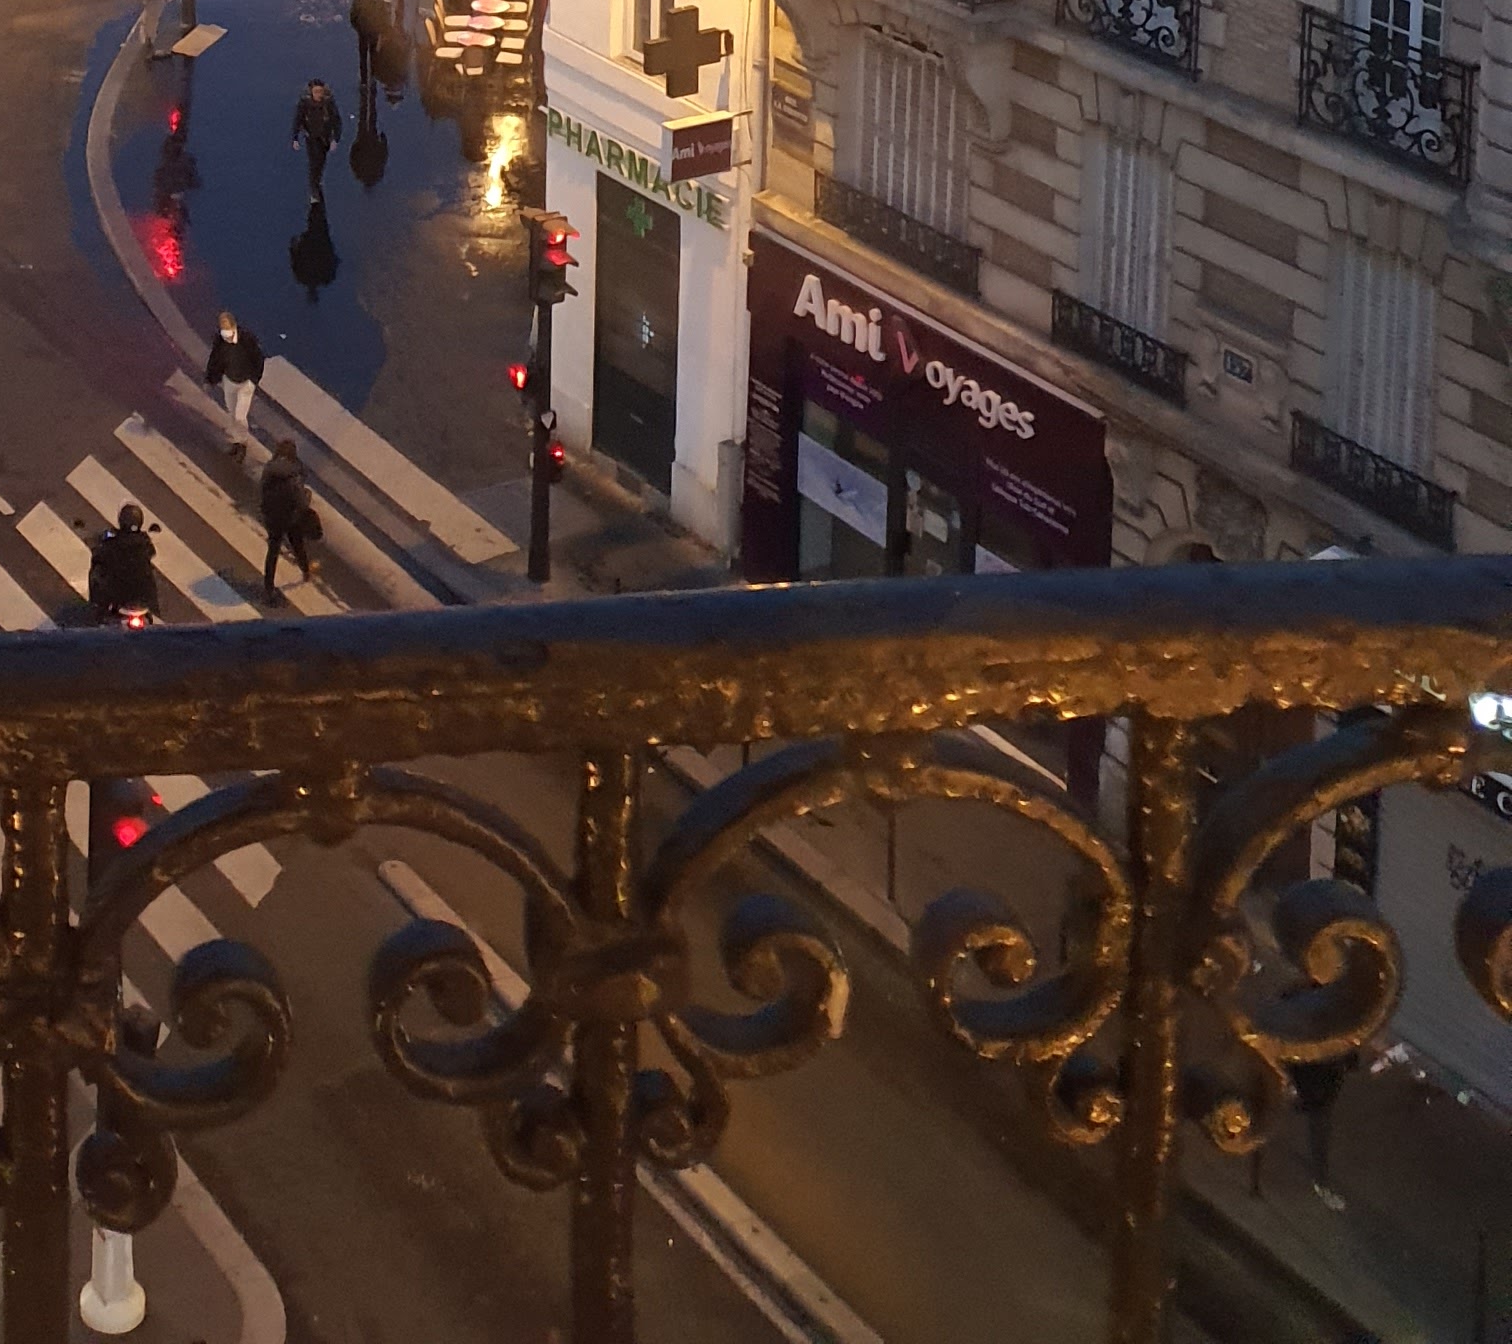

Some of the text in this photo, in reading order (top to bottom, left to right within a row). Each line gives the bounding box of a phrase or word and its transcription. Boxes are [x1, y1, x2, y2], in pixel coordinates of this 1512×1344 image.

[548, 106, 731, 230] PHARMACIE
[672, 142, 695, 161] Ami
[793, 274, 887, 362] Ami
[892, 316, 1036, 440] Voyages
